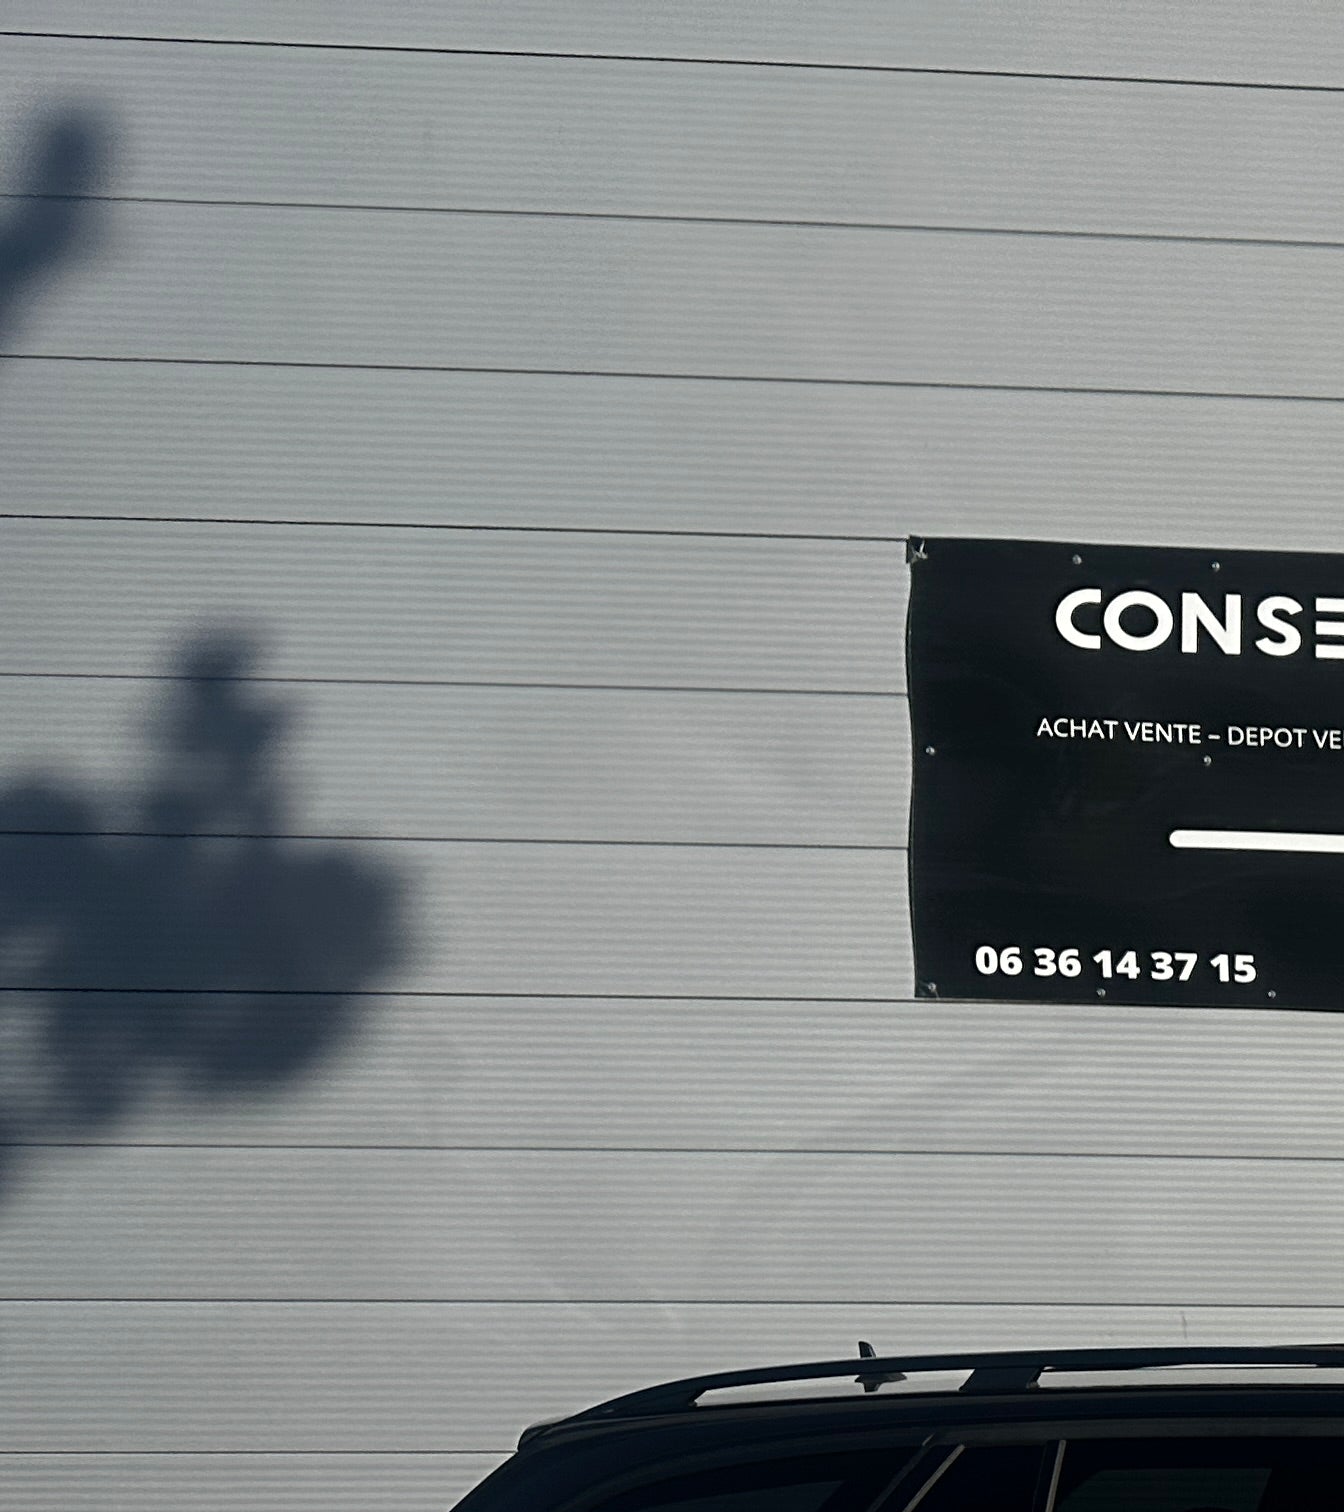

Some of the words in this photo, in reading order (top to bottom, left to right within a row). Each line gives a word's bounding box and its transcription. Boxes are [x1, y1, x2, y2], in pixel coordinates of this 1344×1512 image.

[1036, 717, 1119, 740] ACHAT
[1123, 721, 1202, 745] VENTE
[1227, 726, 1308, 748] DEPOT
[975, 945, 1023, 976] 06
[1033, 947, 1082, 978] 36
[1092, 949, 1141, 980] 14
[1150, 951, 1198, 982] 37
[1210, 953, 1257, 984] 15
